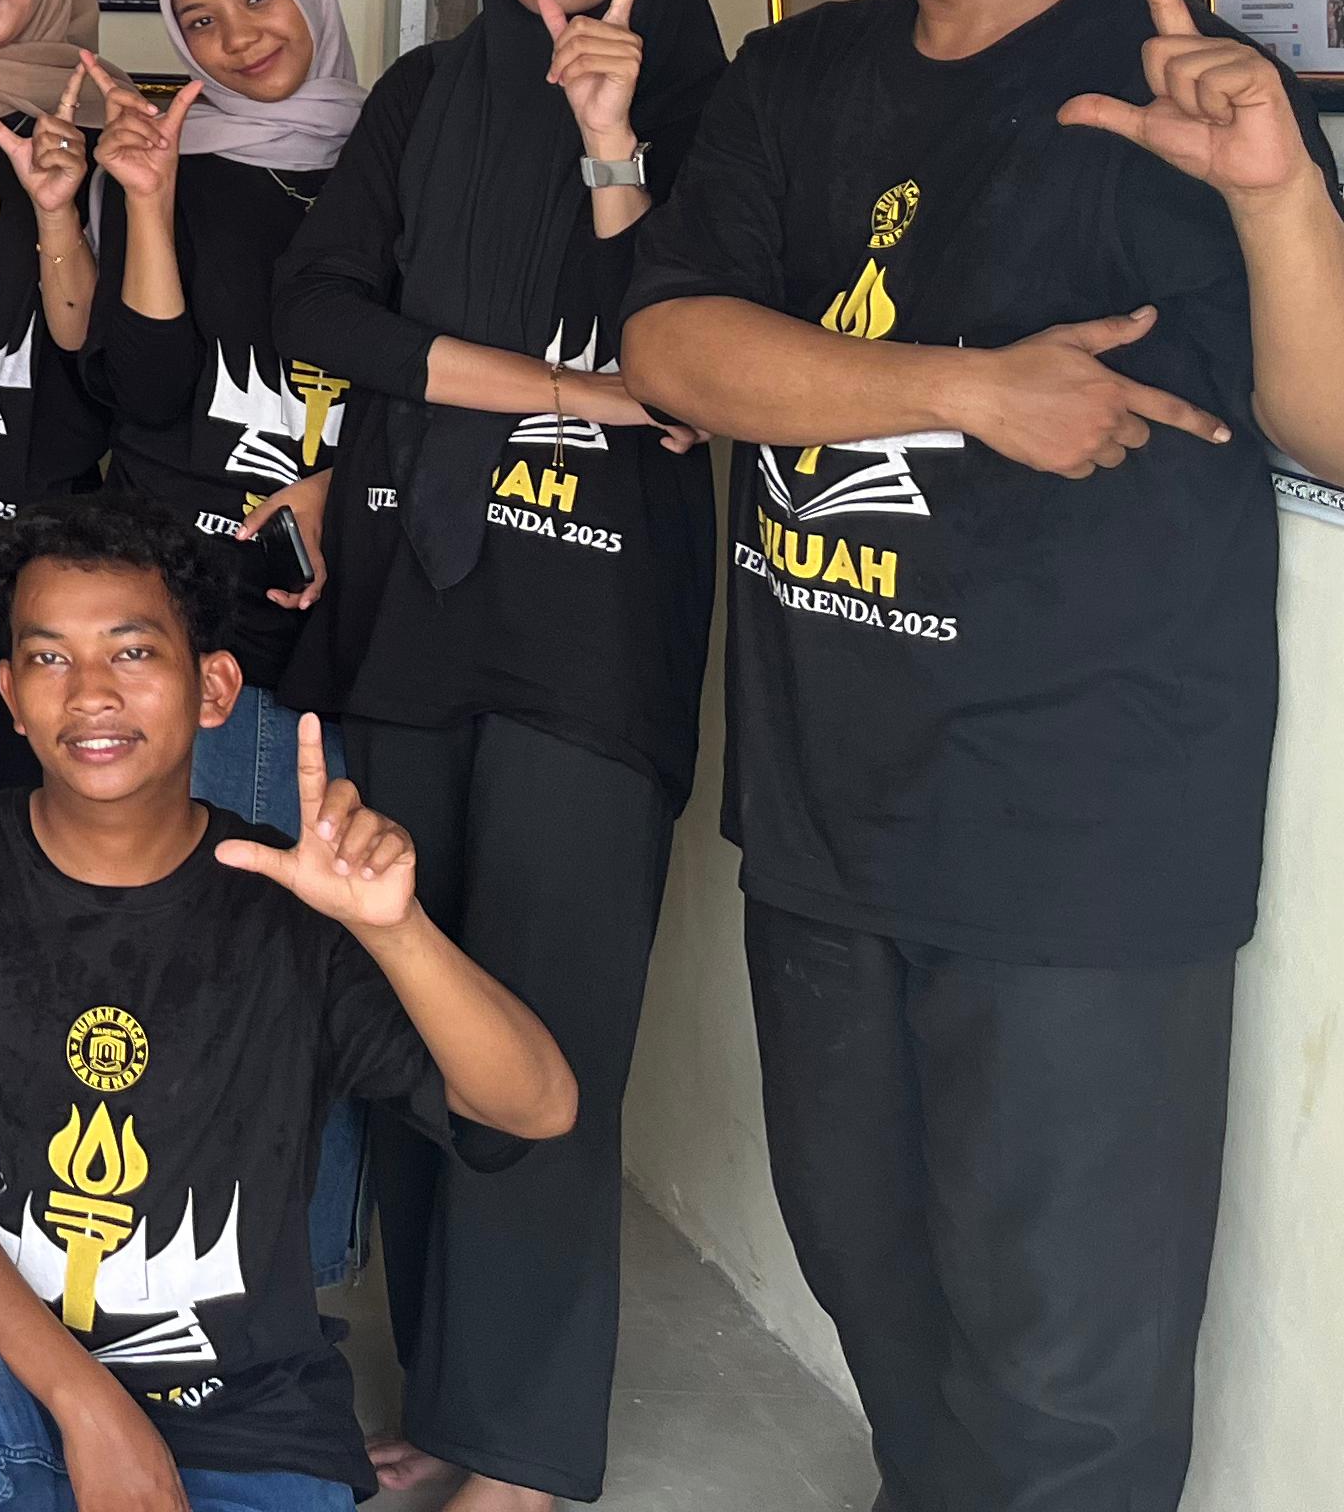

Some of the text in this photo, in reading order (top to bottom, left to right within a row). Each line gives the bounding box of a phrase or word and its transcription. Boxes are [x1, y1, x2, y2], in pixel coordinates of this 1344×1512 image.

[562, 523, 622, 553] 2025
[888, 609, 958, 641] 2025
[69, 1007, 146, 1046] RUMAH BACA
[70, 1054, 143, 1090] MARENDA
